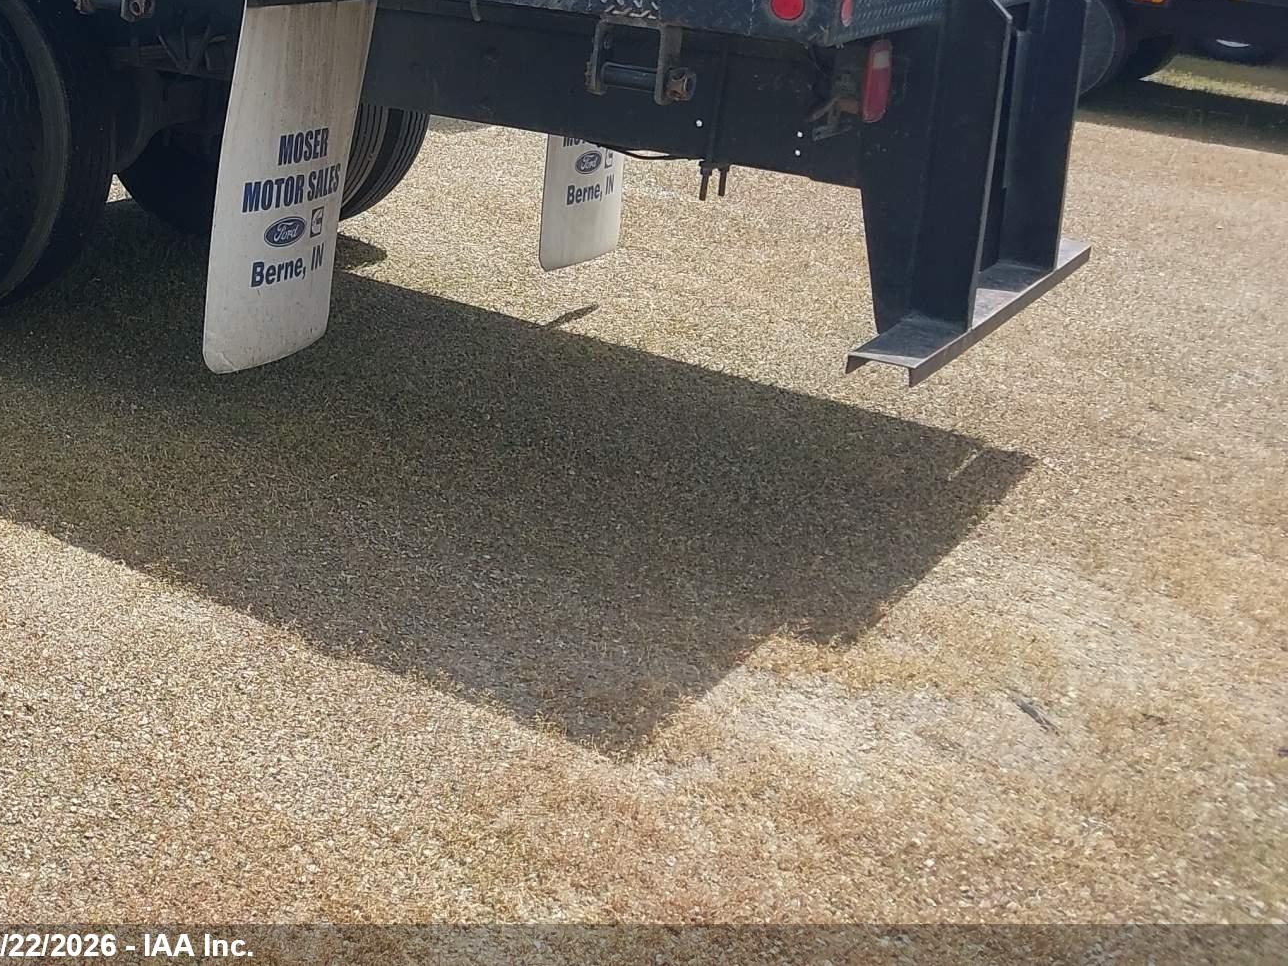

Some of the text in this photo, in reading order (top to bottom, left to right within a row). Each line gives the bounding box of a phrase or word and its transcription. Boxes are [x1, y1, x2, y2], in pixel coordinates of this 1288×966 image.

[278, 127, 329, 166] MOSER
[242, 163, 341, 213] MOTOR SALES
[566, 174, 615, 206] Berne, IN
[270, 220, 302, 244] Ford
[251, 243, 325, 287] Berne, IN
